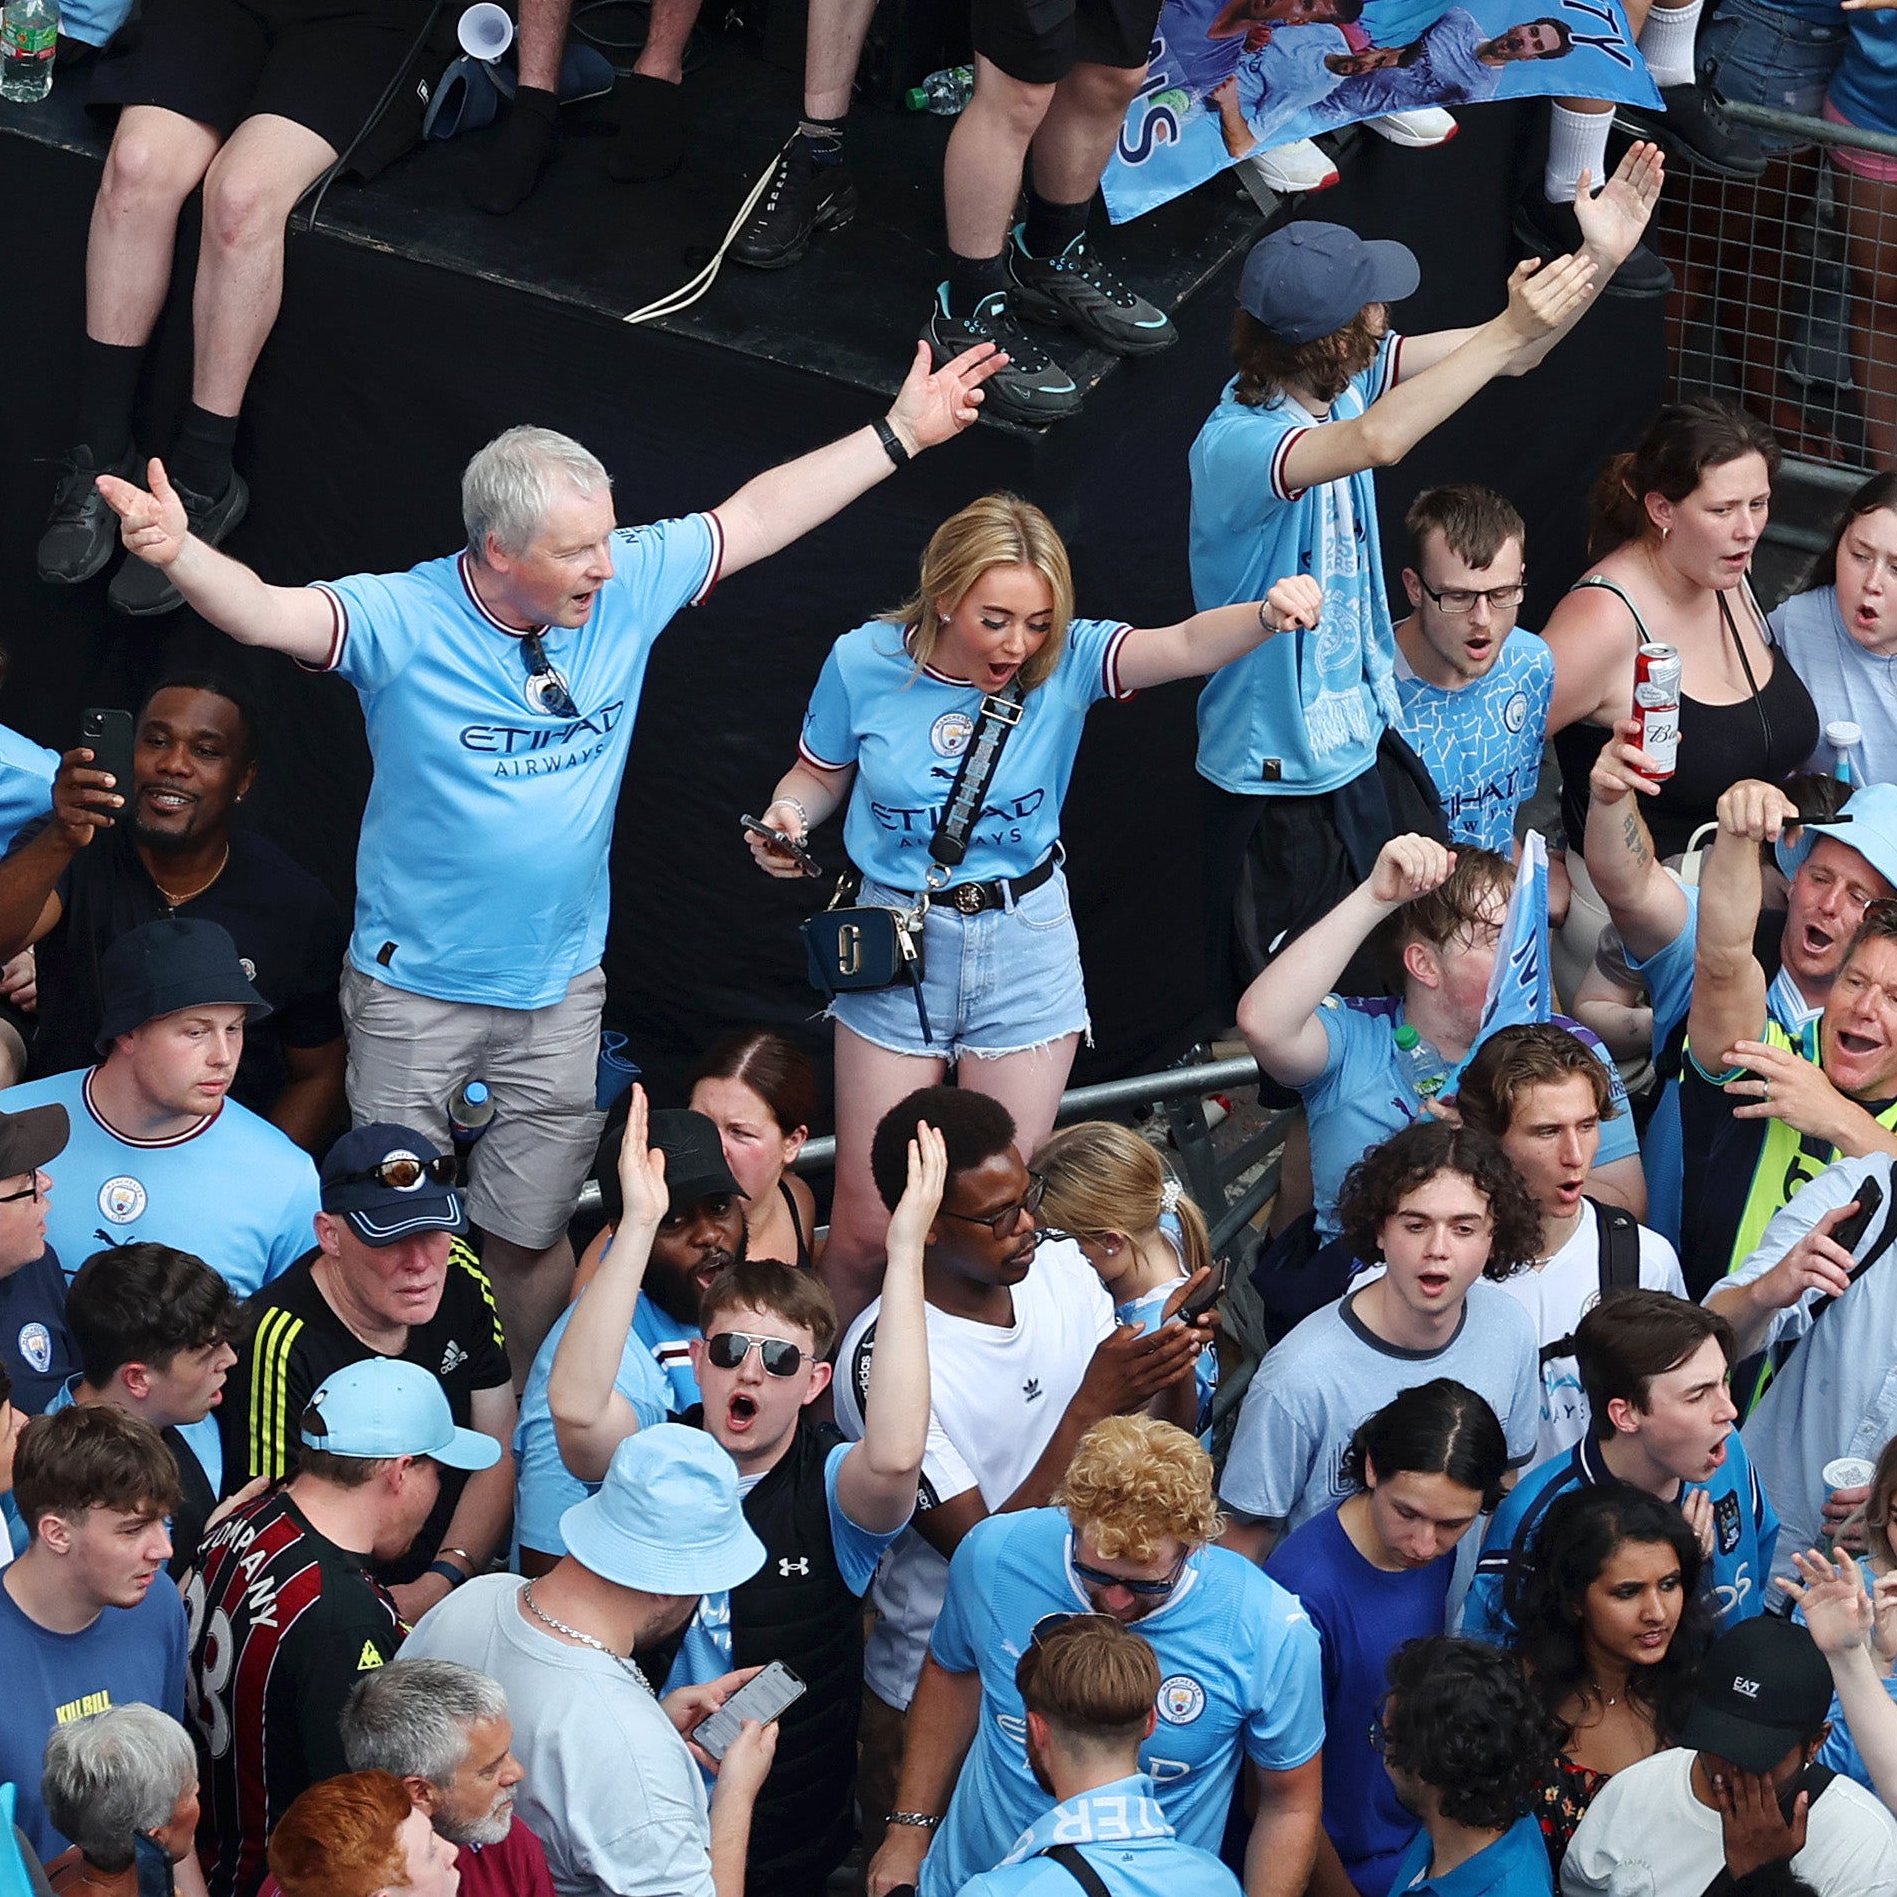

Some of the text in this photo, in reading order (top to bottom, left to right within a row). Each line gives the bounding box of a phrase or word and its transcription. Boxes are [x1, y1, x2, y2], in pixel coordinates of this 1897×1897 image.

[459, 702, 625, 753] ETIHAD
[493, 743, 606, 779] AIRWAYS
[440, 1351, 469, 1376] adidas
[1733, 1675, 1761, 1694] EA7
[55, 1689, 112, 1726] KILL BILL
